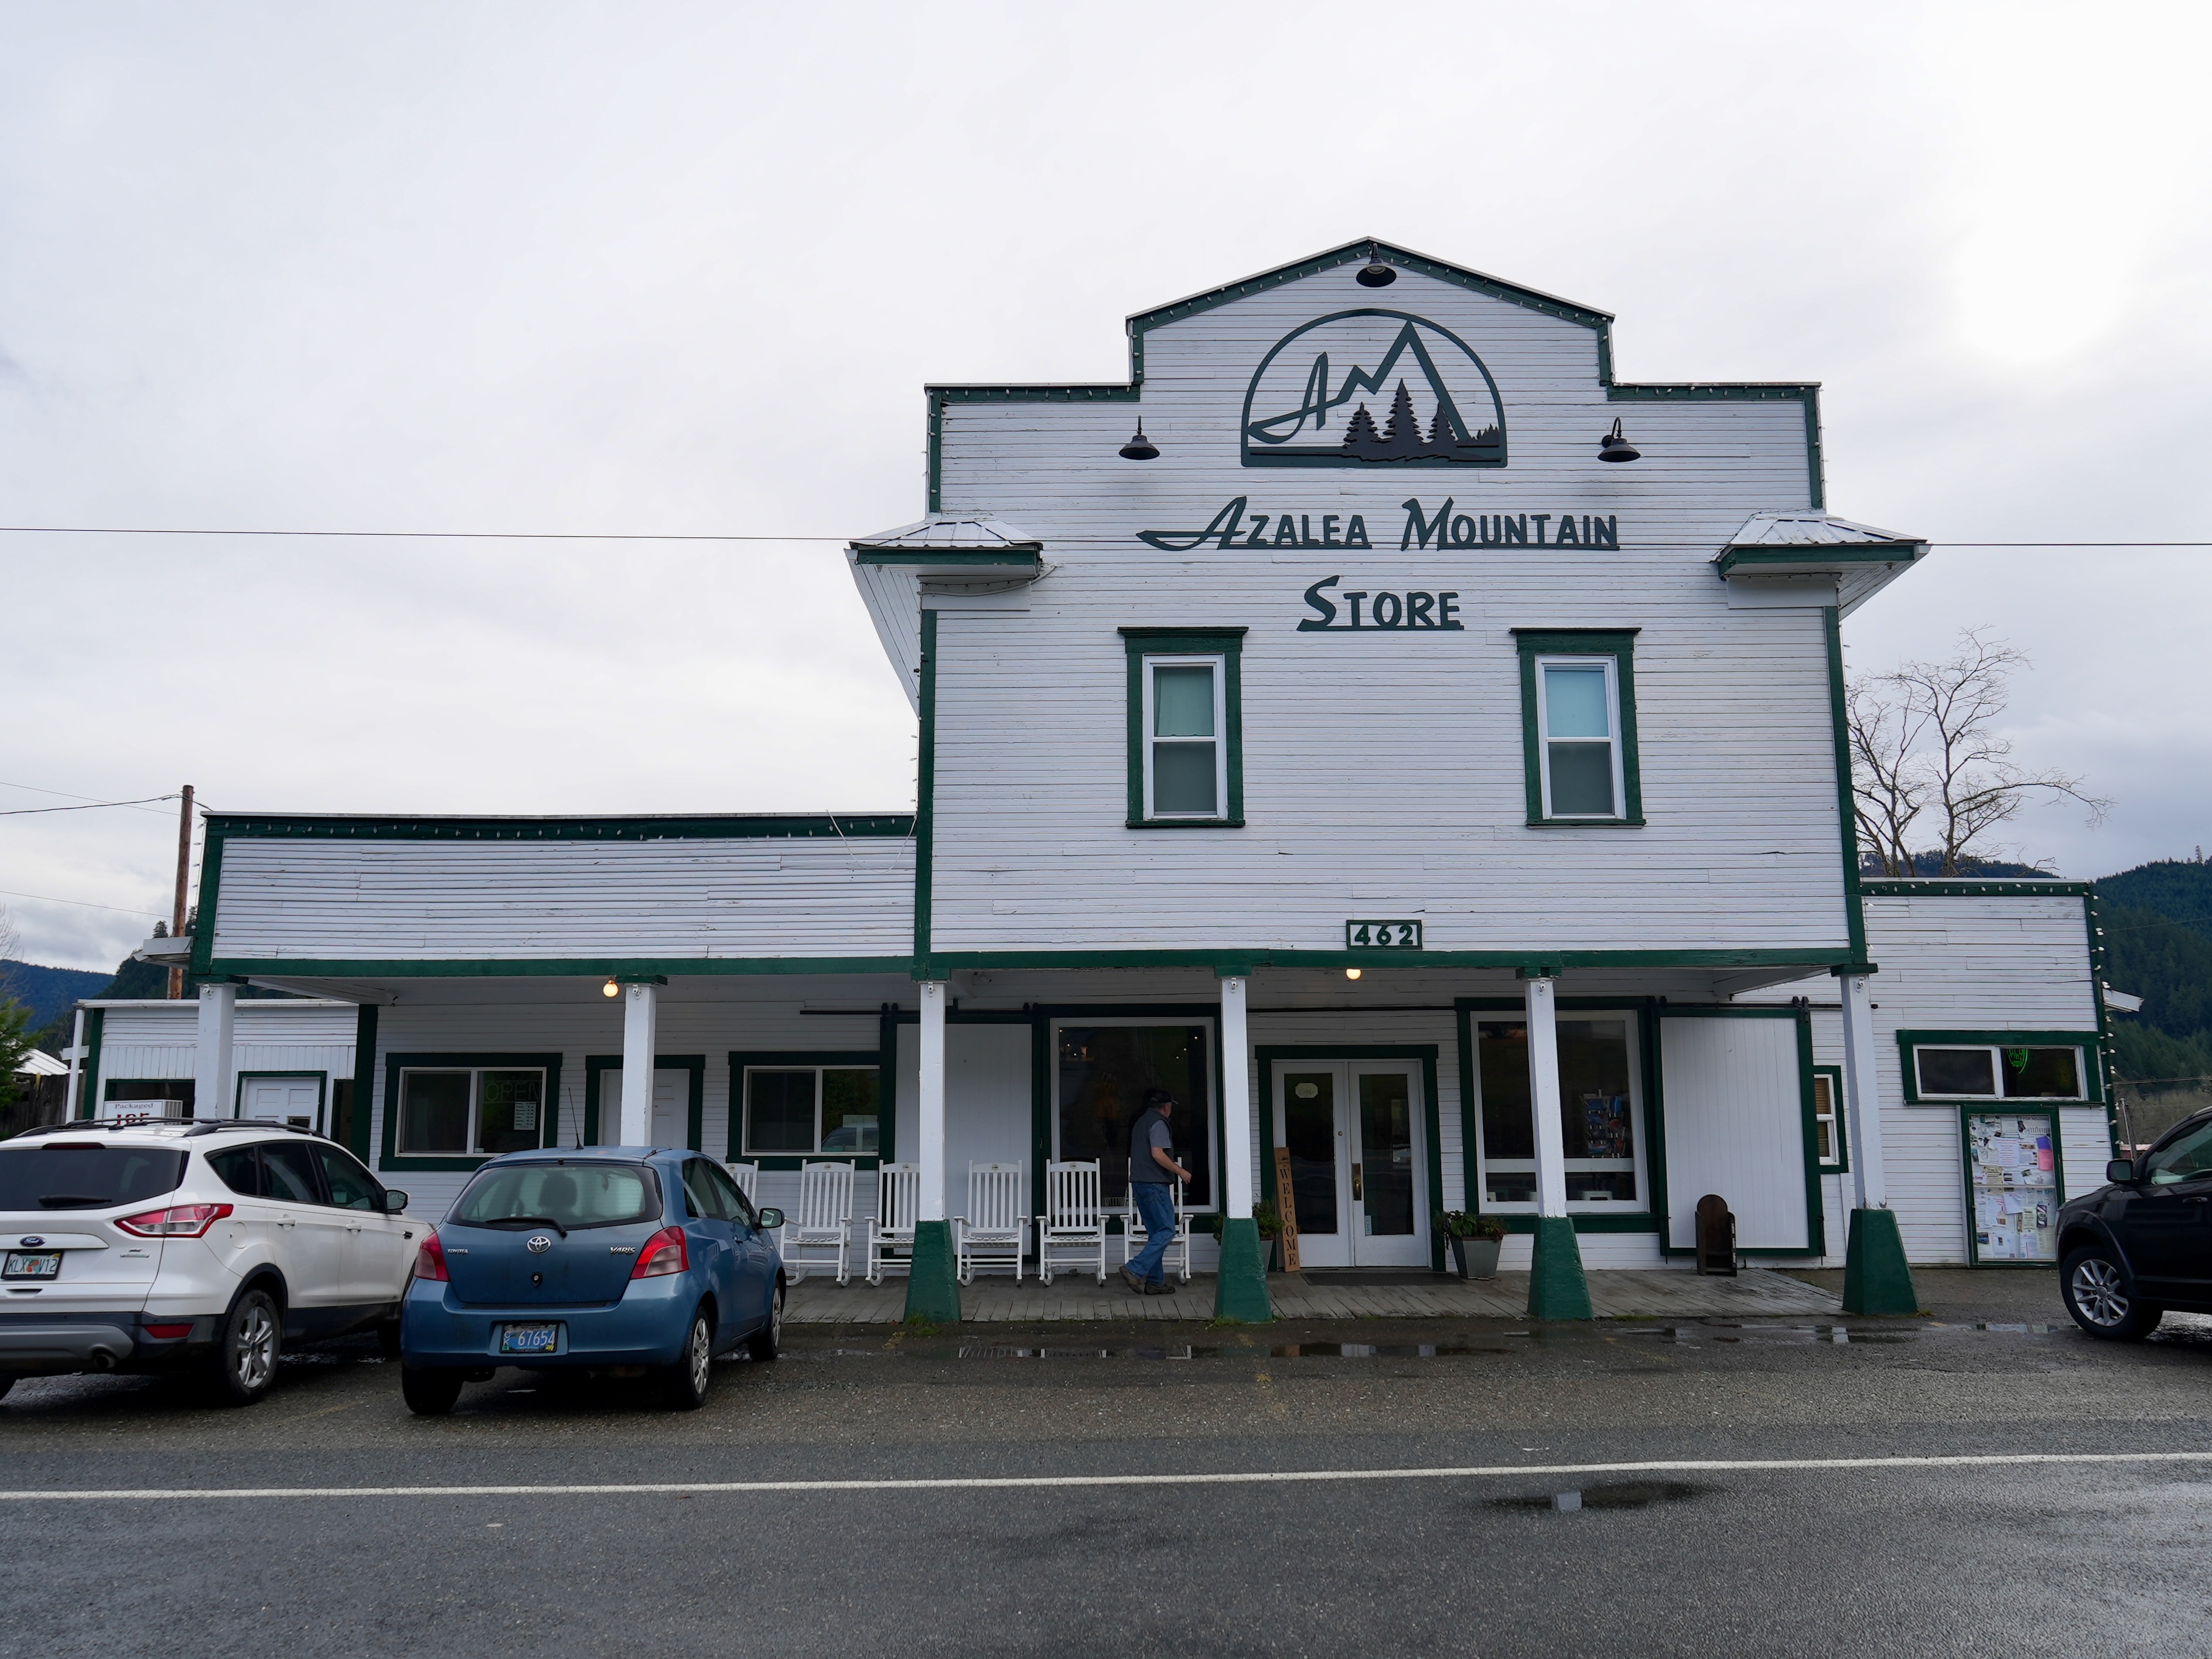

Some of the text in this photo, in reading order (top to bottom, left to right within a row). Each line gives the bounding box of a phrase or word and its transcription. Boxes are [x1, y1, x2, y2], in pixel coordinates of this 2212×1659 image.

[1136, 496, 1620, 551] AZALEA MOUNTAIN
[1296, 575, 1465, 631] STORE
[1354, 924, 1413, 945] 462
[485, 1082, 541, 1101] OPEN
[1279, 1169, 1296, 1265] WELCOME
[609, 1246, 636, 1255] YARIS
[518, 1330, 555, 1346] 67654
